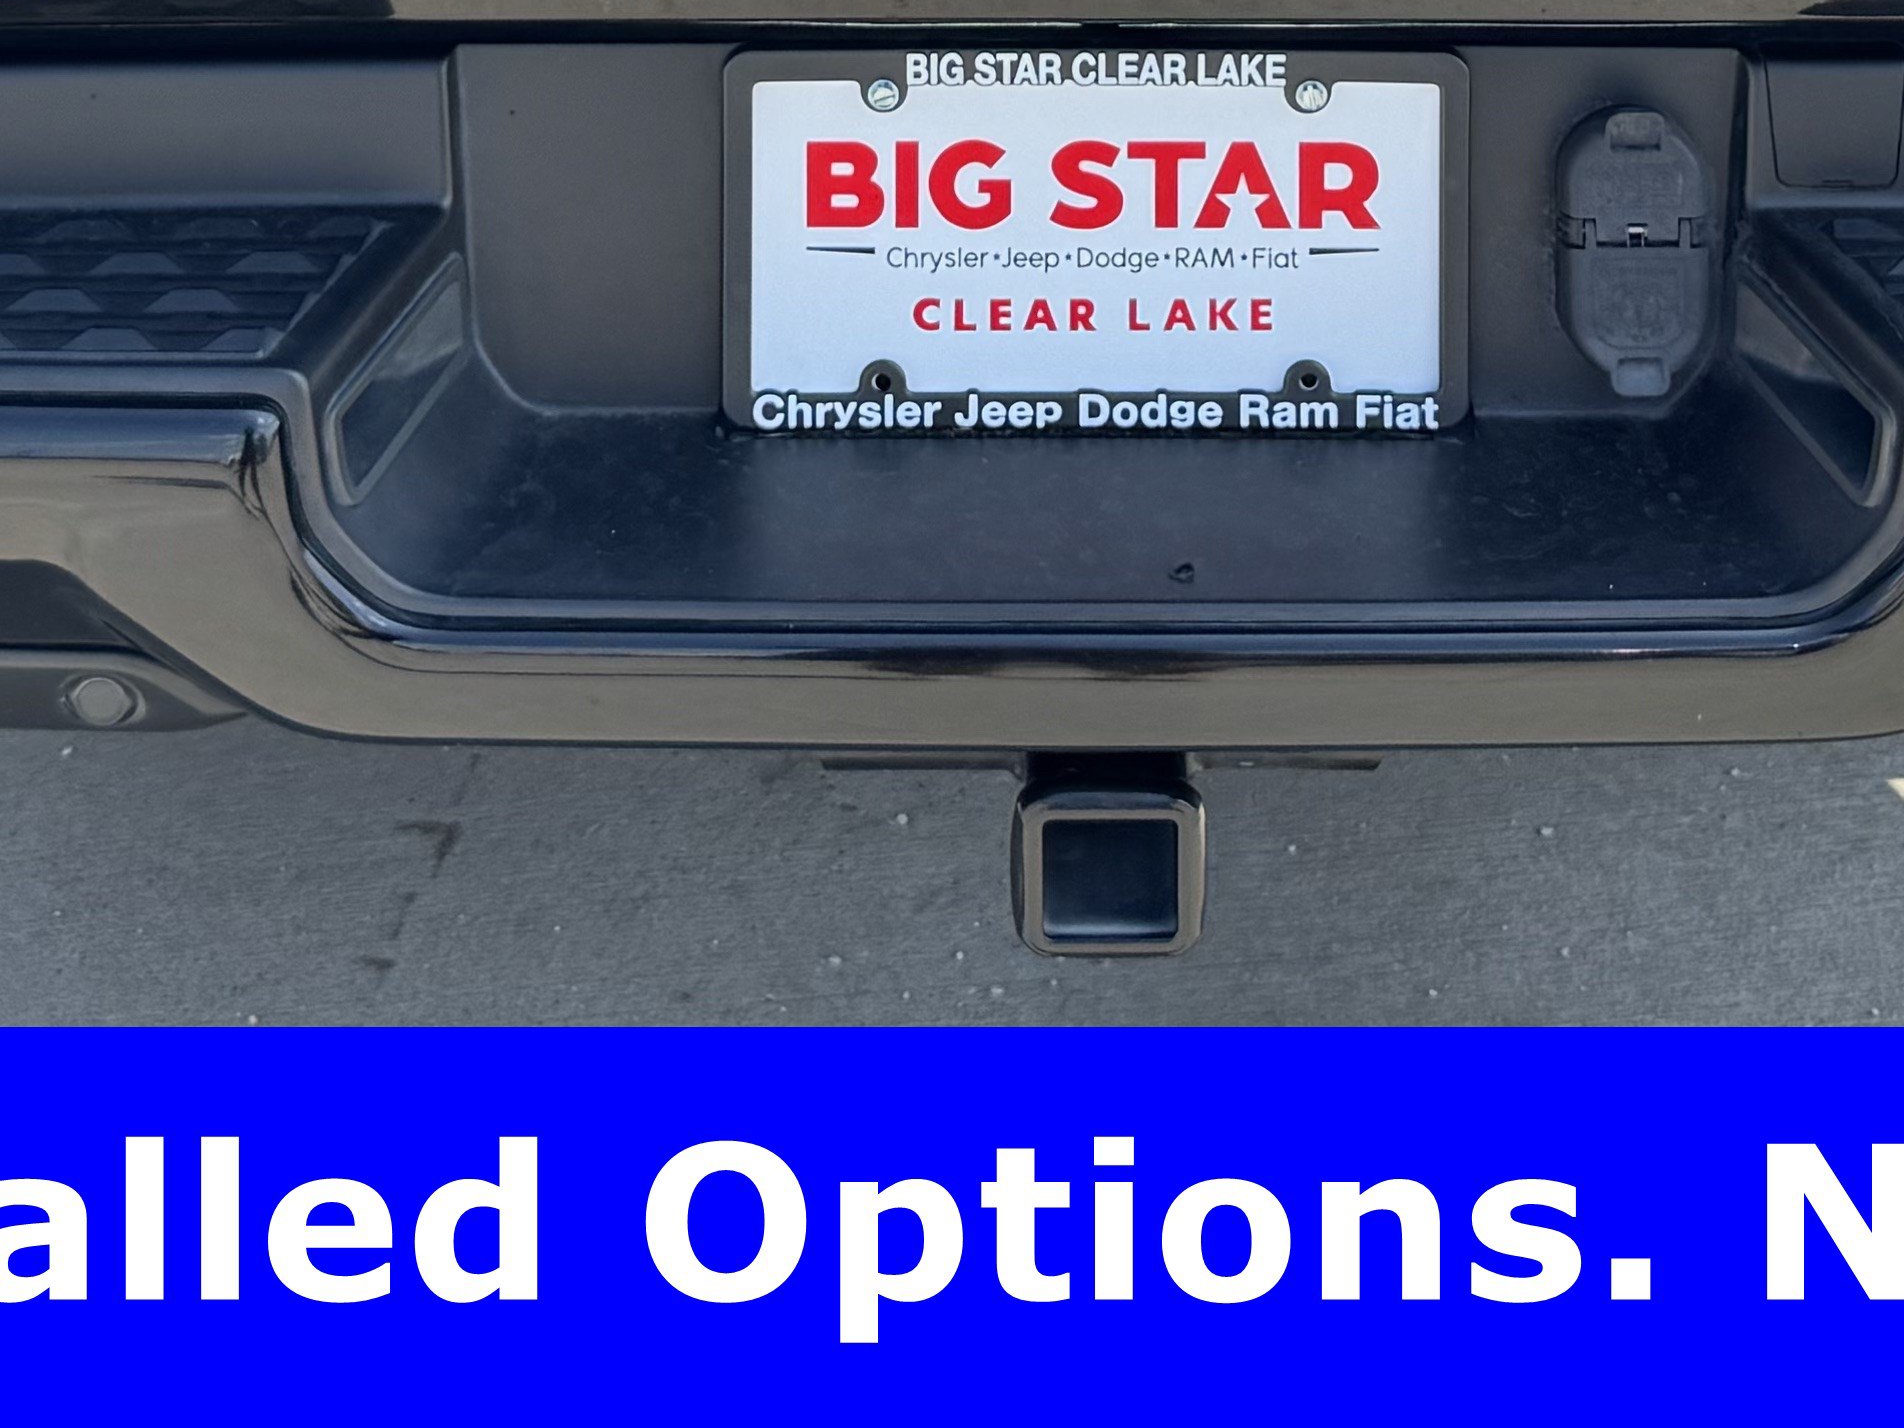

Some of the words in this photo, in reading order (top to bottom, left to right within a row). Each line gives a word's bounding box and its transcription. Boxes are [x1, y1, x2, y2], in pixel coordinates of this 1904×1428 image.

[905, 51, 965, 86] BIG
[973, 51, 1063, 86] STAR
[1071, 51, 1187, 86] CLEAR
[1196, 52, 1288, 87] LAKE
[806, 139, 1013, 230] BIG
[1049, 139, 1381, 230] STAR
[886, 246, 990, 273] Chrysler
[1001, 246, 1060, 274] Jeep
[1076, 246, 1160, 273] Dodge
[1174, 247, 1236, 269] RAM
[1252, 247, 1299, 269] Fiat
[912, 297, 1097, 332] CLEAR
[1127, 297, 1274, 332] LAKE
[751, 392, 942, 431] Chrysler
[953, 393, 1064, 431] Jeep
[1077, 393, 1224, 430] Dodge
[1238, 394, 1340, 429] Ram
[1354, 394, 1440, 430] Fiat
